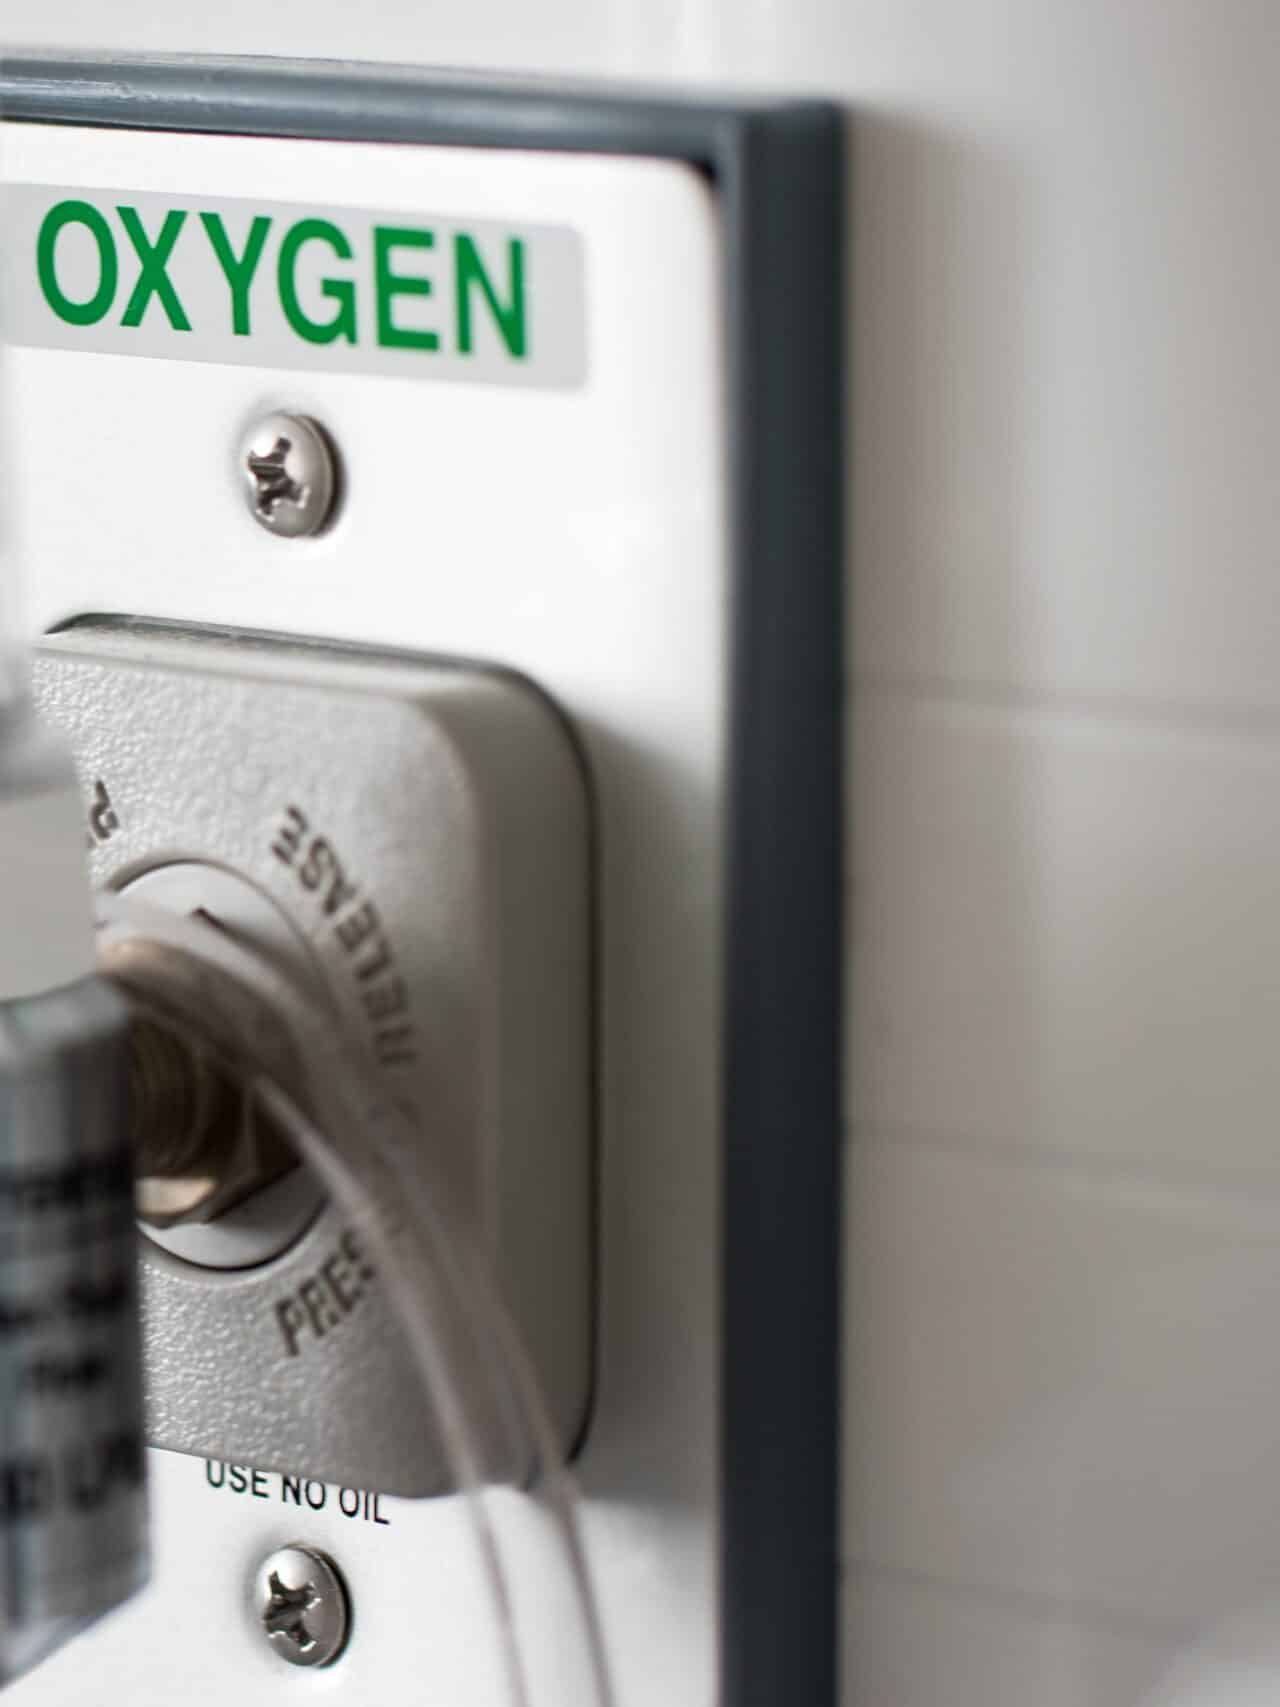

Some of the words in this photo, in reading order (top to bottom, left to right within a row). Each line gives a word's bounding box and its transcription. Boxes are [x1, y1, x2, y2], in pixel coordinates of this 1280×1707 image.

[36, 199, 529, 362] OXYGEN
[274, 1228, 380, 1358] PRES
[206, 1458, 270, 1499] USE
[282, 1474, 326, 1511] NO
[339, 1487, 390, 1526] OIL
